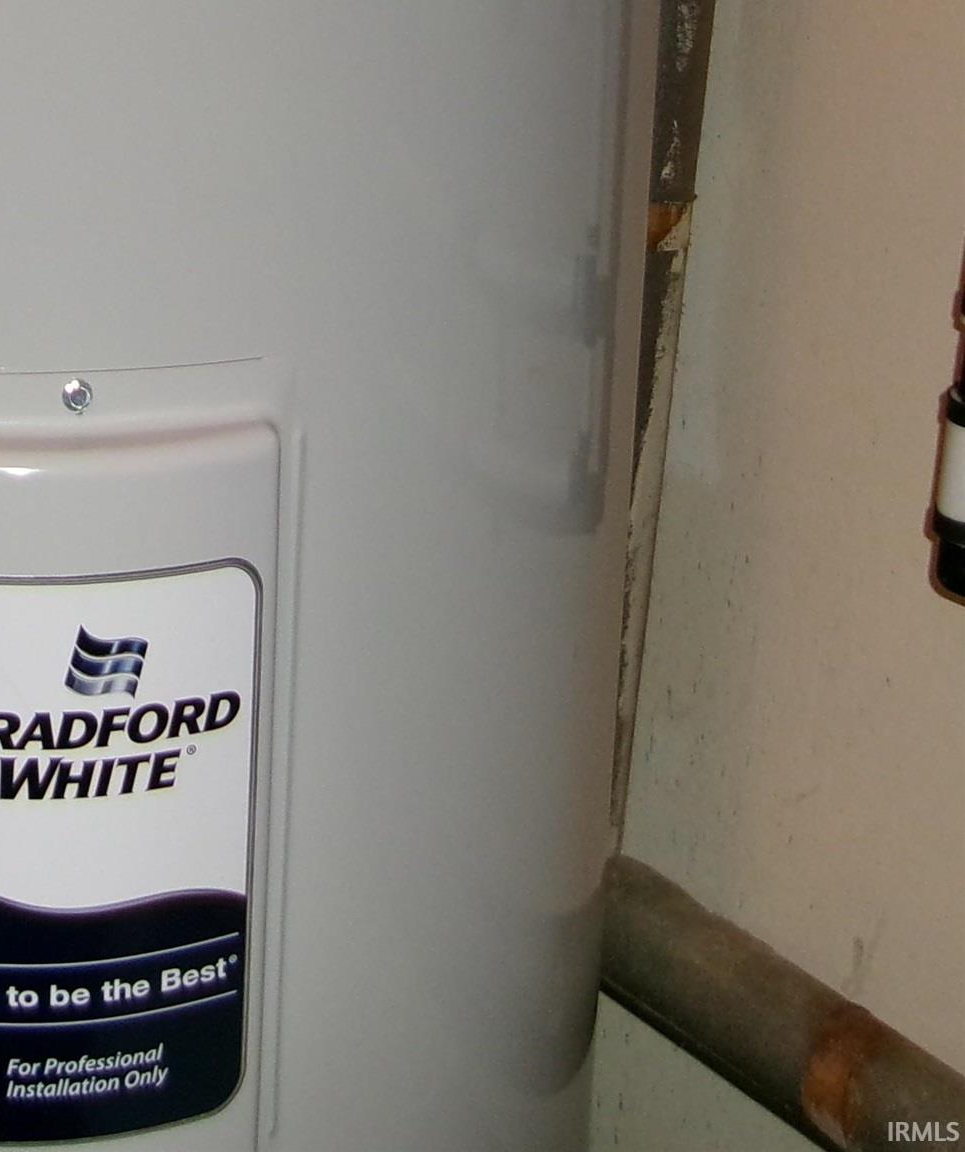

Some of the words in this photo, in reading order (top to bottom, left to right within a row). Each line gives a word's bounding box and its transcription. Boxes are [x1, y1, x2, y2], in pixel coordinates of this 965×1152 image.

[6, 985, 39, 1008] to
[50, 984, 90, 1007] be
[101, 978, 150, 1002] the
[6, 1057, 40, 1076] For
[44, 1043, 164, 1075] Professional
[6, 1076, 120, 1099] Installation
[124, 1065, 169, 1088] Only
